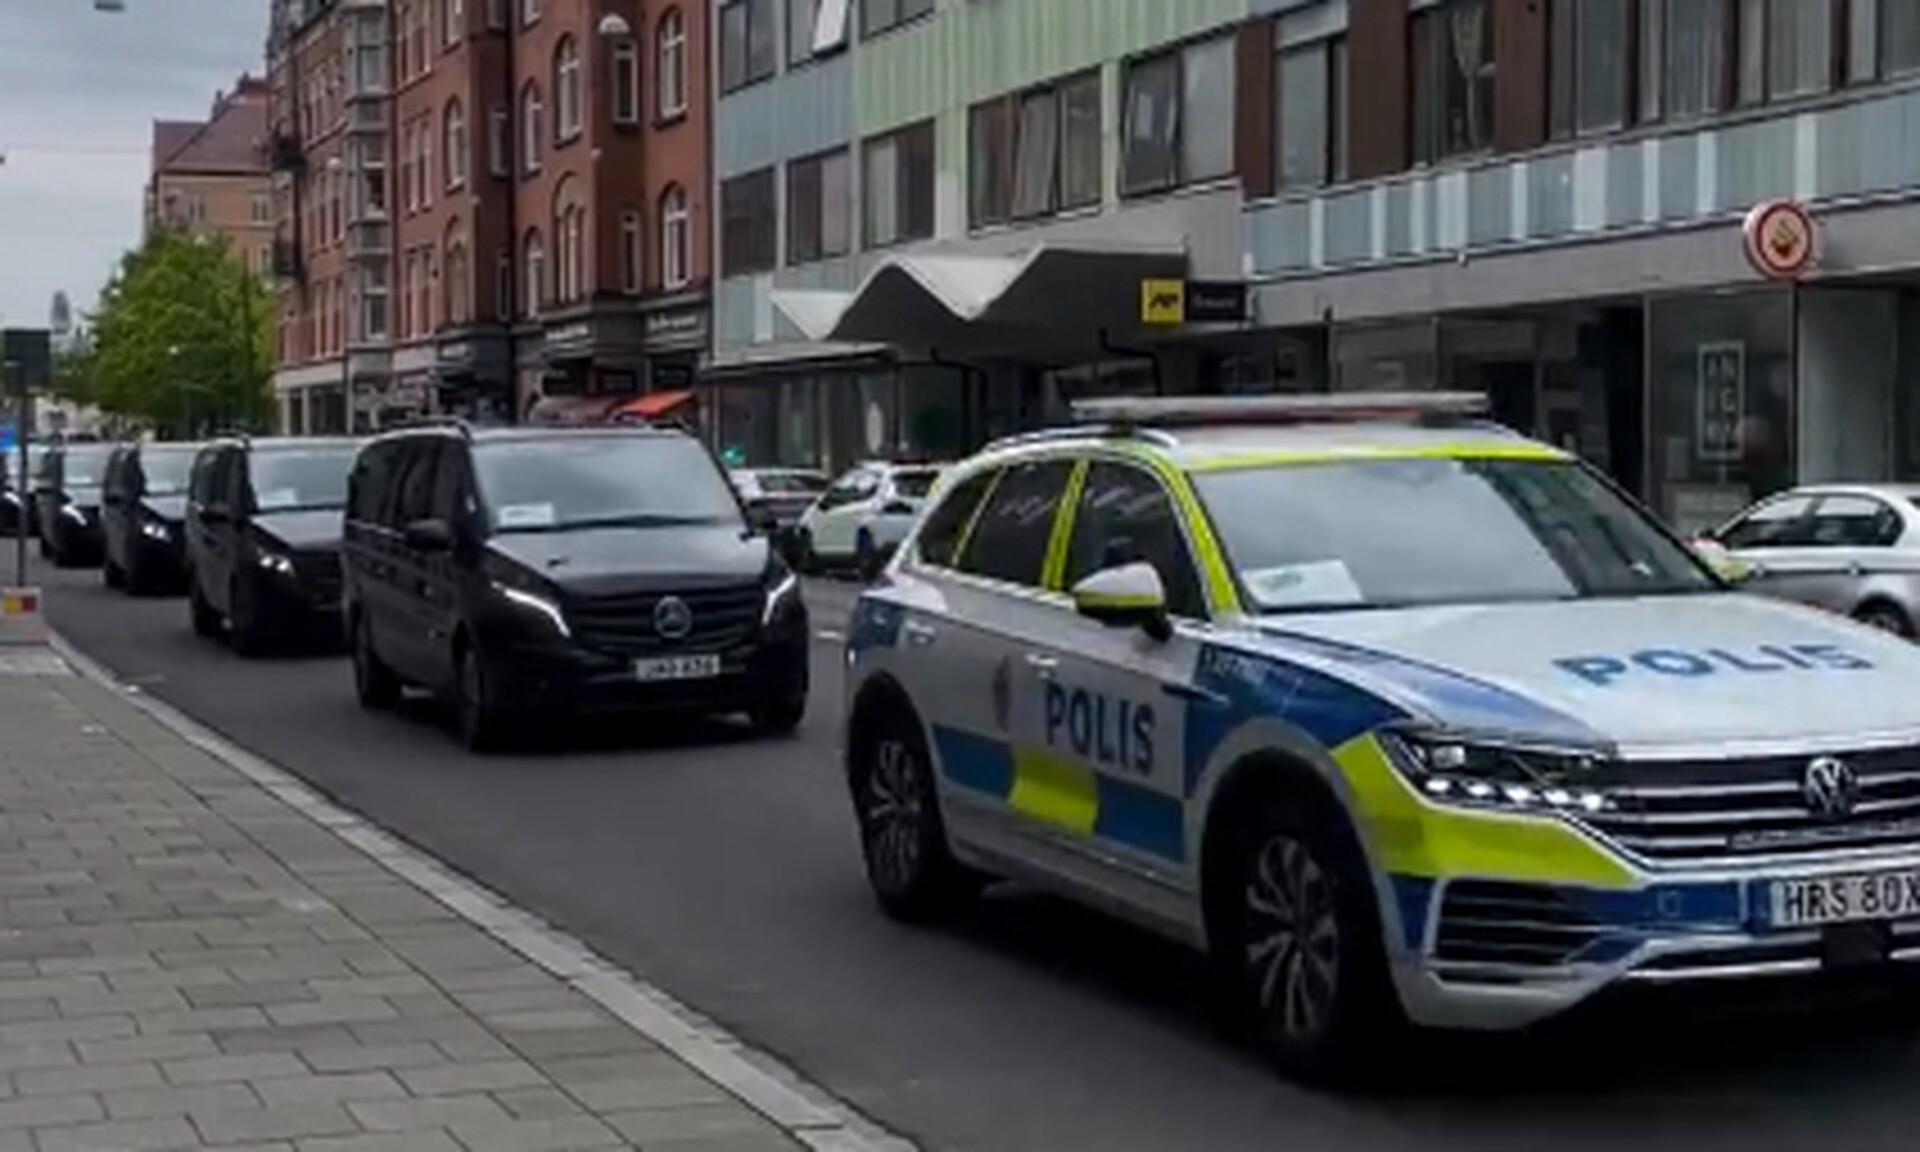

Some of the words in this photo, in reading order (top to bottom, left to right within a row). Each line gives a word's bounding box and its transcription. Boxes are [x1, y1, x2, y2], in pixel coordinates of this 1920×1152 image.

[1552, 645, 1875, 686] POLIS
[1045, 679, 1156, 778] POLIS
[1784, 881, 1849, 920] HRS
